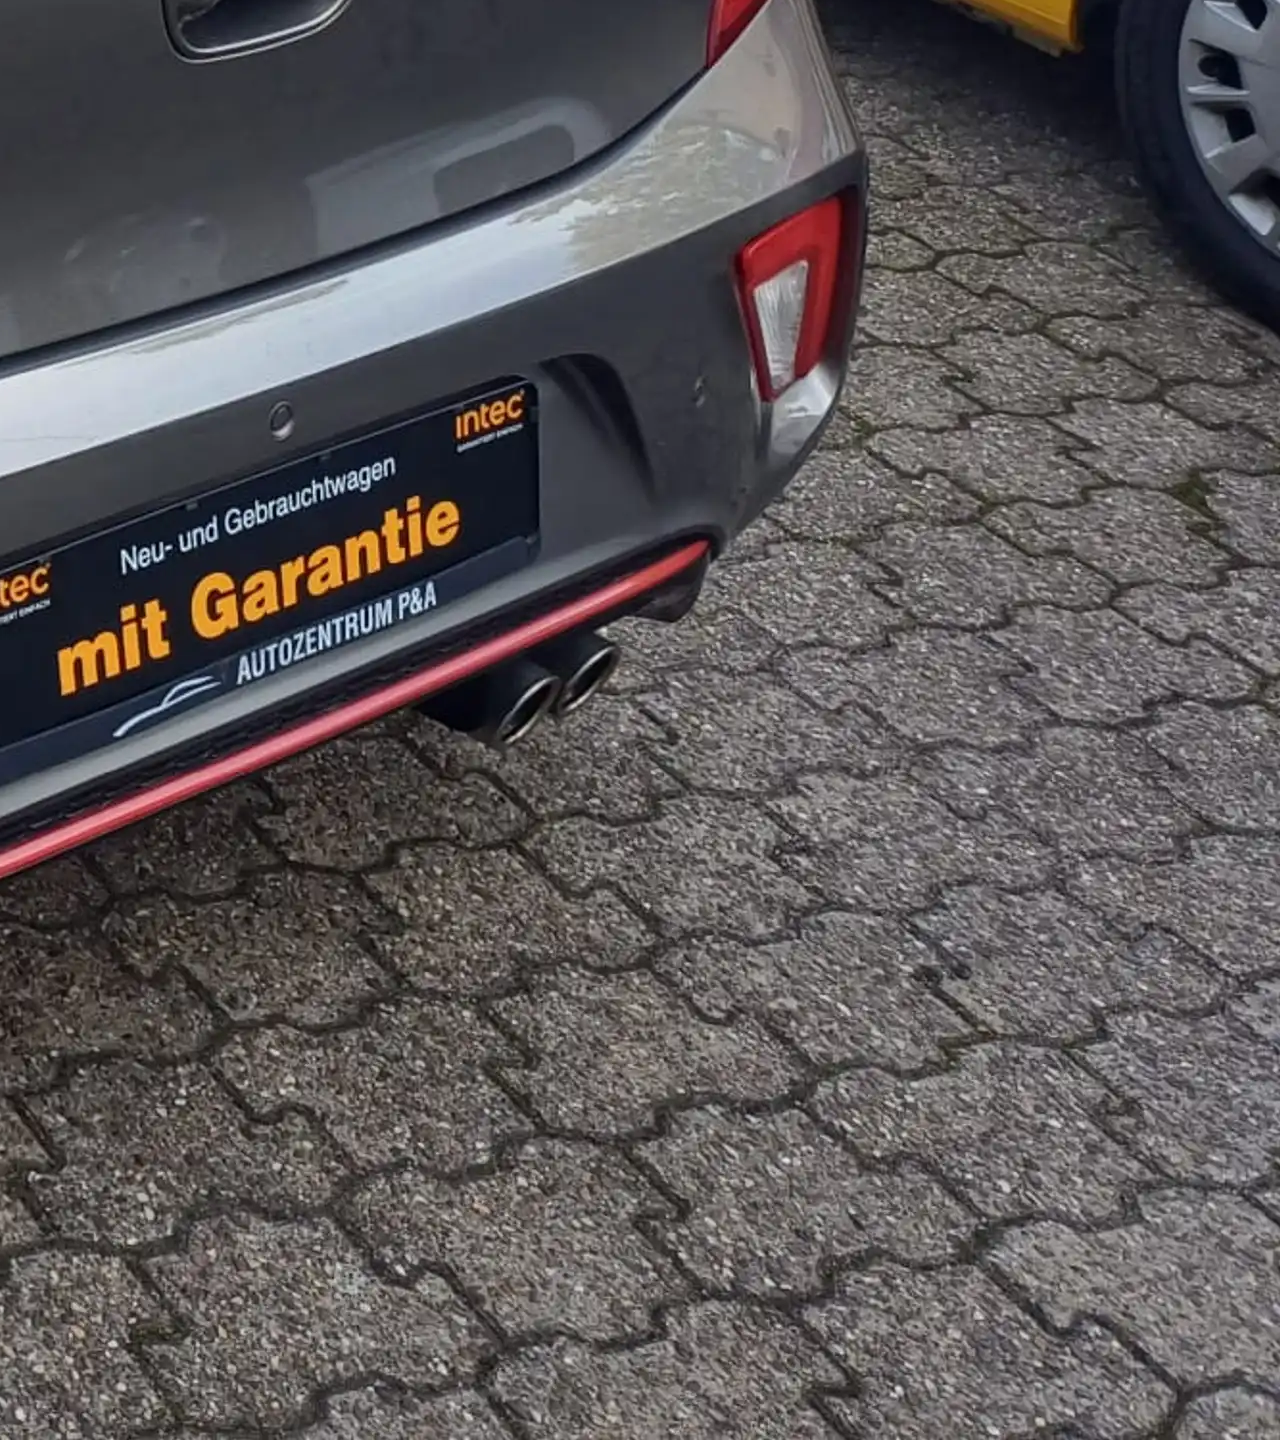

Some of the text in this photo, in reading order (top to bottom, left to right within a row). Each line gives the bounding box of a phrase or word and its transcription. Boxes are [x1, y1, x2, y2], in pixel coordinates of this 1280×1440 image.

[119, 456, 397, 575] Neu- und Gebrauchtwagen
[57, 494, 462, 697] mit Garantie
[236, 581, 438, 685] AUTOZENTRUM P&A
